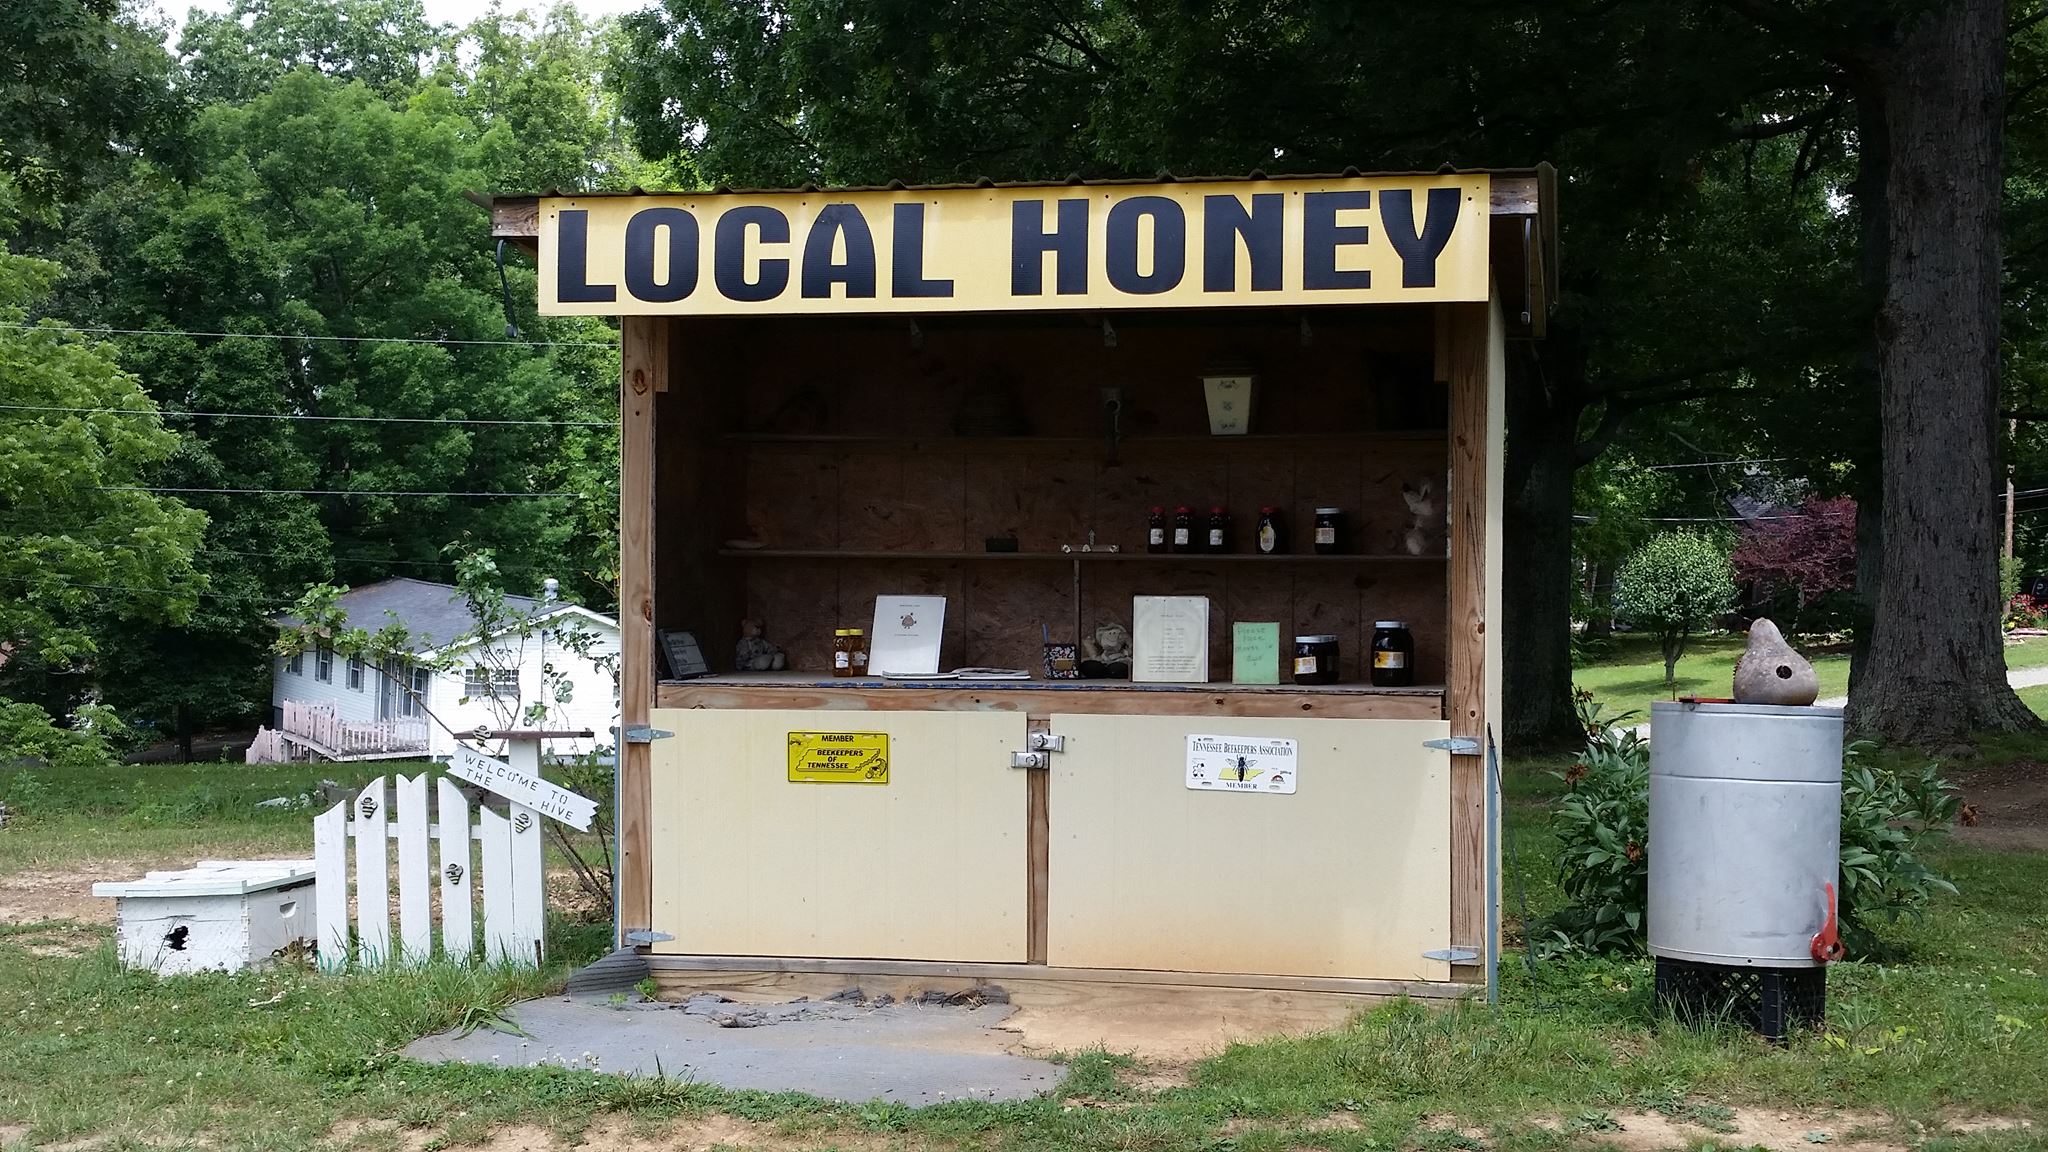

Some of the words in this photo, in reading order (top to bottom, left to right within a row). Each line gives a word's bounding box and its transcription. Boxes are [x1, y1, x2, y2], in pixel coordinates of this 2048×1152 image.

[557, 203, 954, 303] LOCAL
[1011, 187, 1462, 296] HONEY
[464, 753, 539, 792] WELCOME
[551, 789, 568, 805] TO
[465, 767, 493, 787] THE
[540, 800, 574, 821] HIVE
